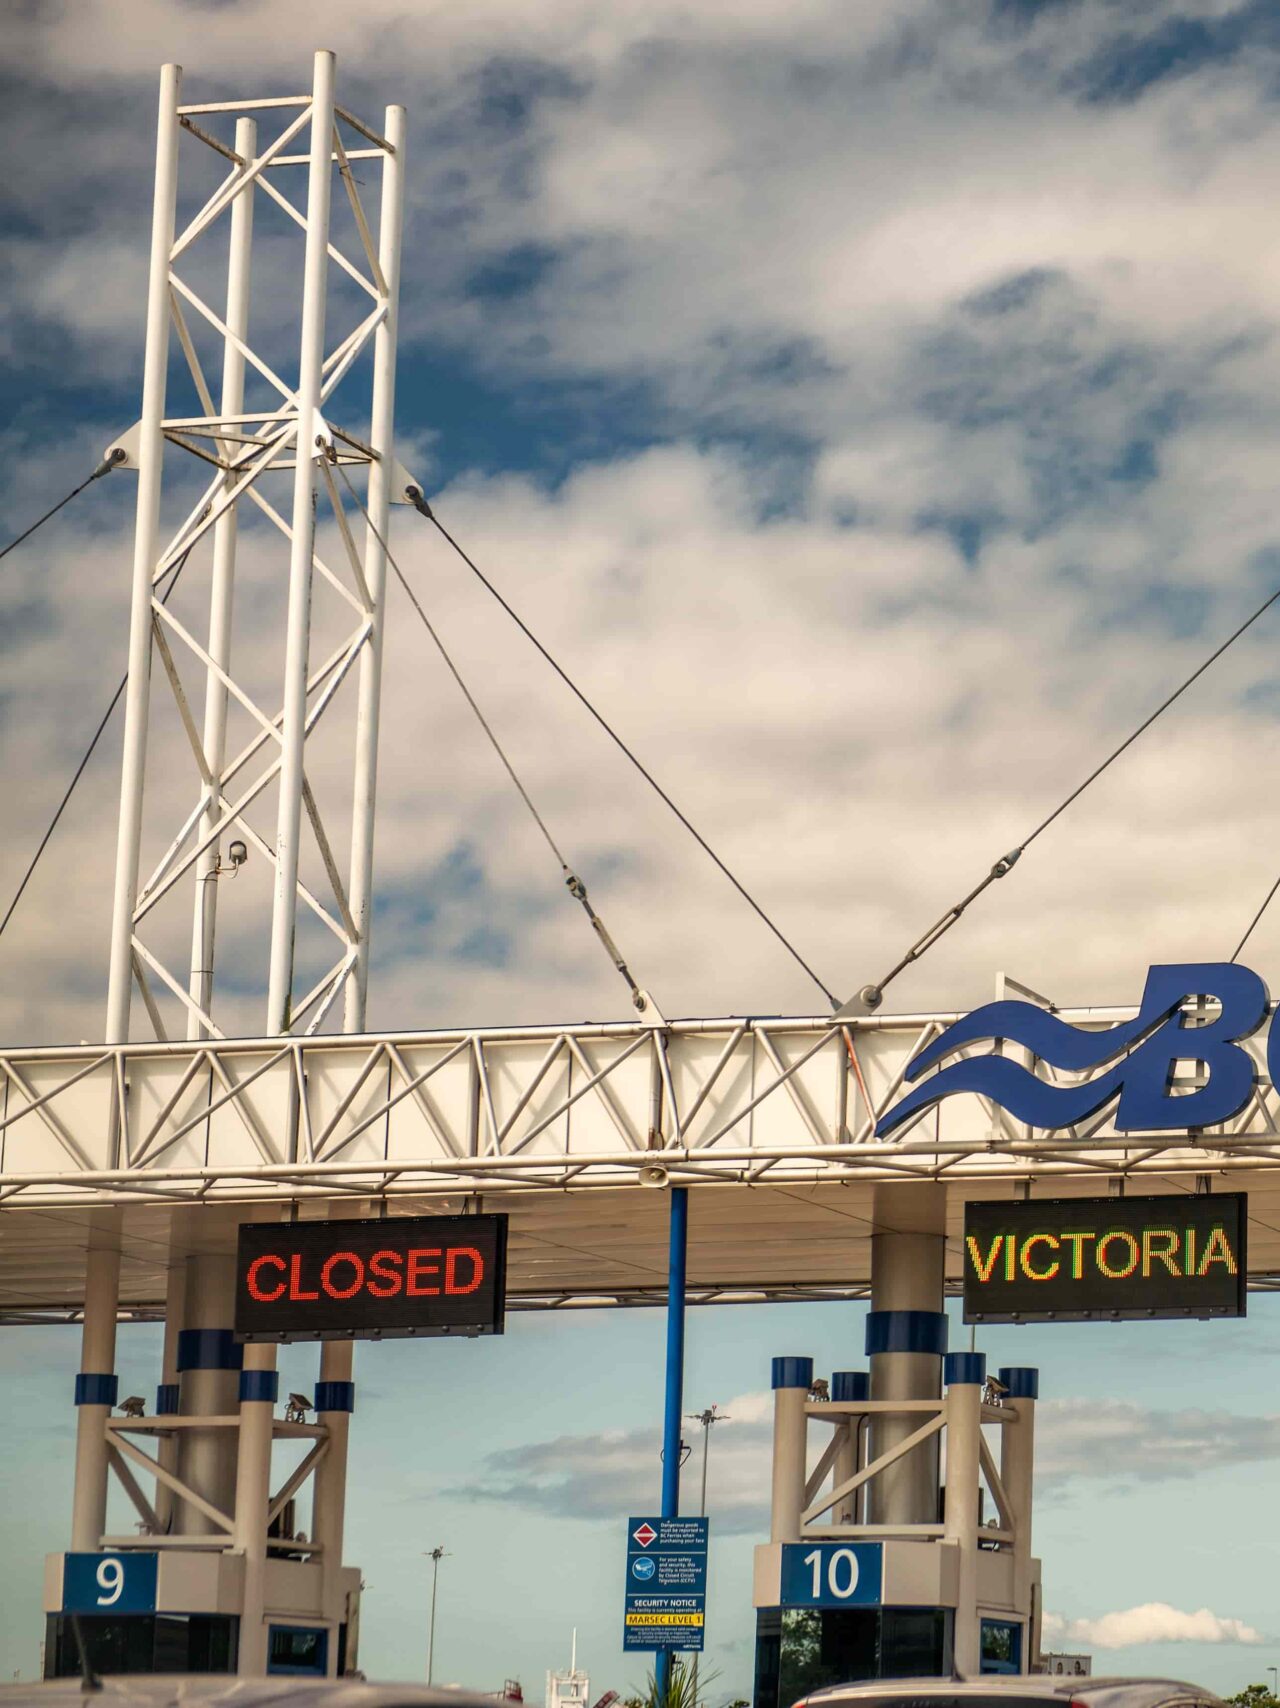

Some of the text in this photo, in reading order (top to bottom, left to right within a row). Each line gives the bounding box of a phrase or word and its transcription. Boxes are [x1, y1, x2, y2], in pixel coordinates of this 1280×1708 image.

[246, 1247, 484, 1302] CLOSED
[965, 1227, 1238, 1282] VICTORIA
[95, 1558, 125, 1606] 9
[803, 1548, 860, 1599] 10
